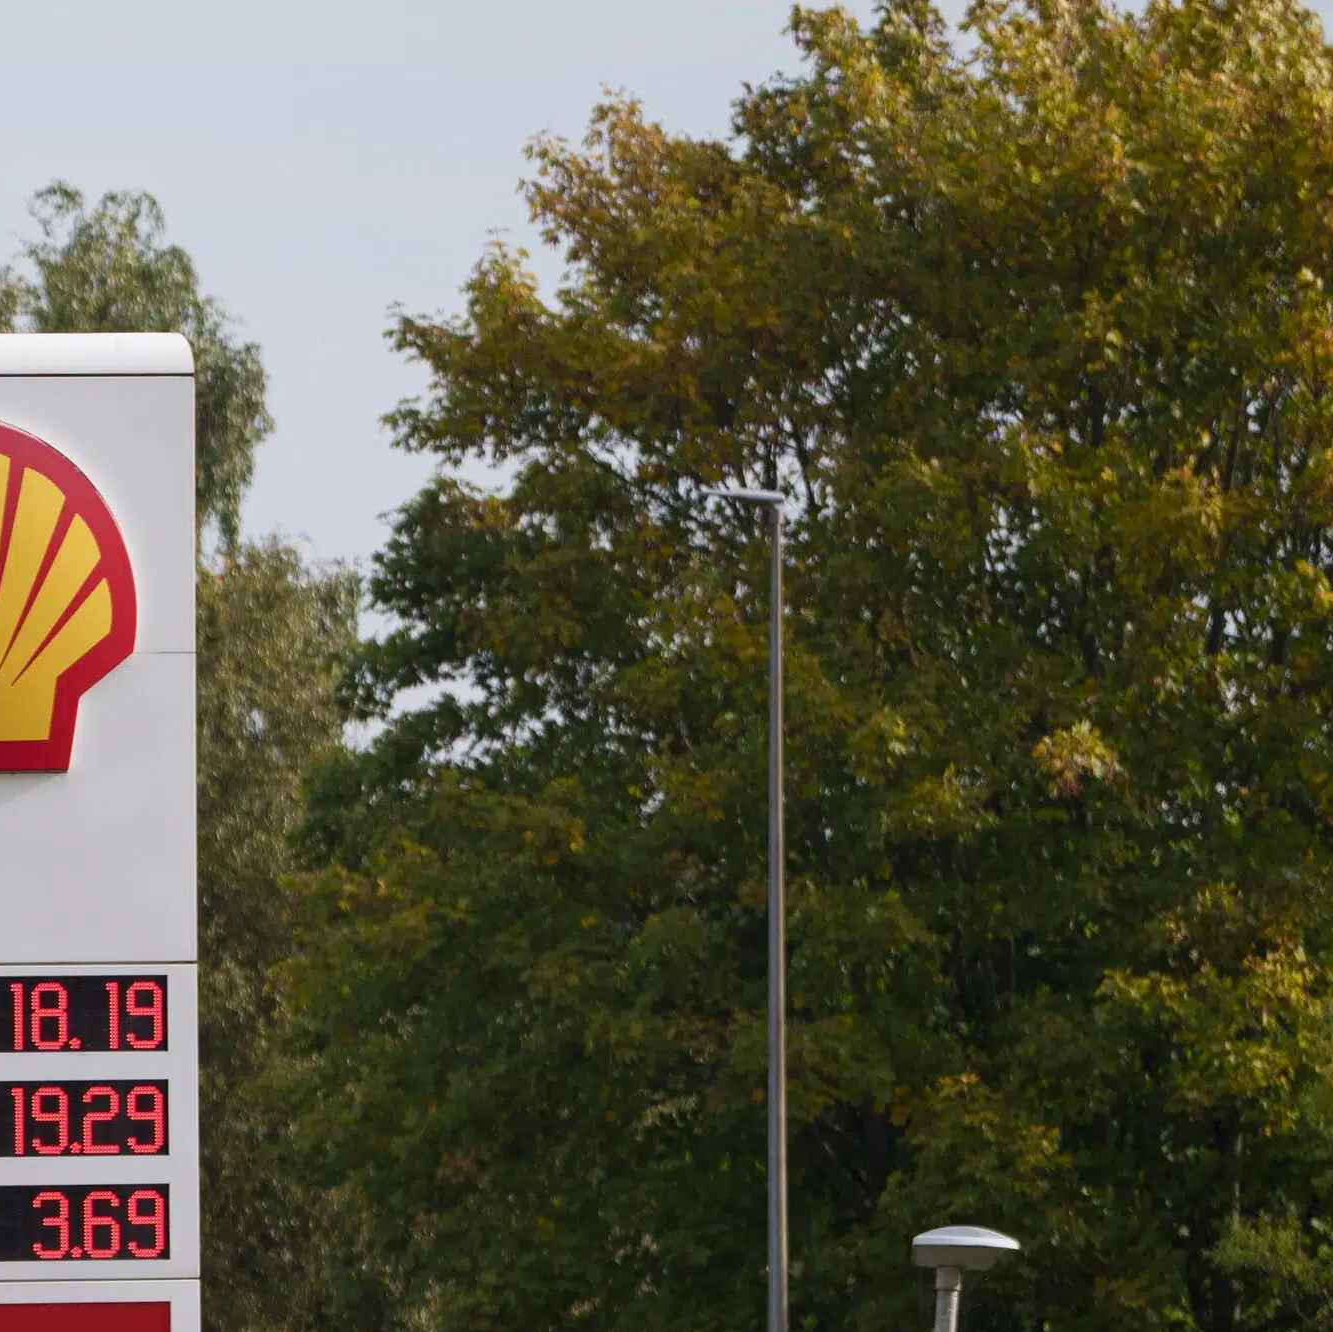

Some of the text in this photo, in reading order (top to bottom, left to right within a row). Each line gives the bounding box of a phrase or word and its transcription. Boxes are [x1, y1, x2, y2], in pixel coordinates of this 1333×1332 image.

[10, 981, 164, 1050] 18.19
[11, 1085, 165, 1155] 19.29
[32, 1190, 165, 1259] 3.69
